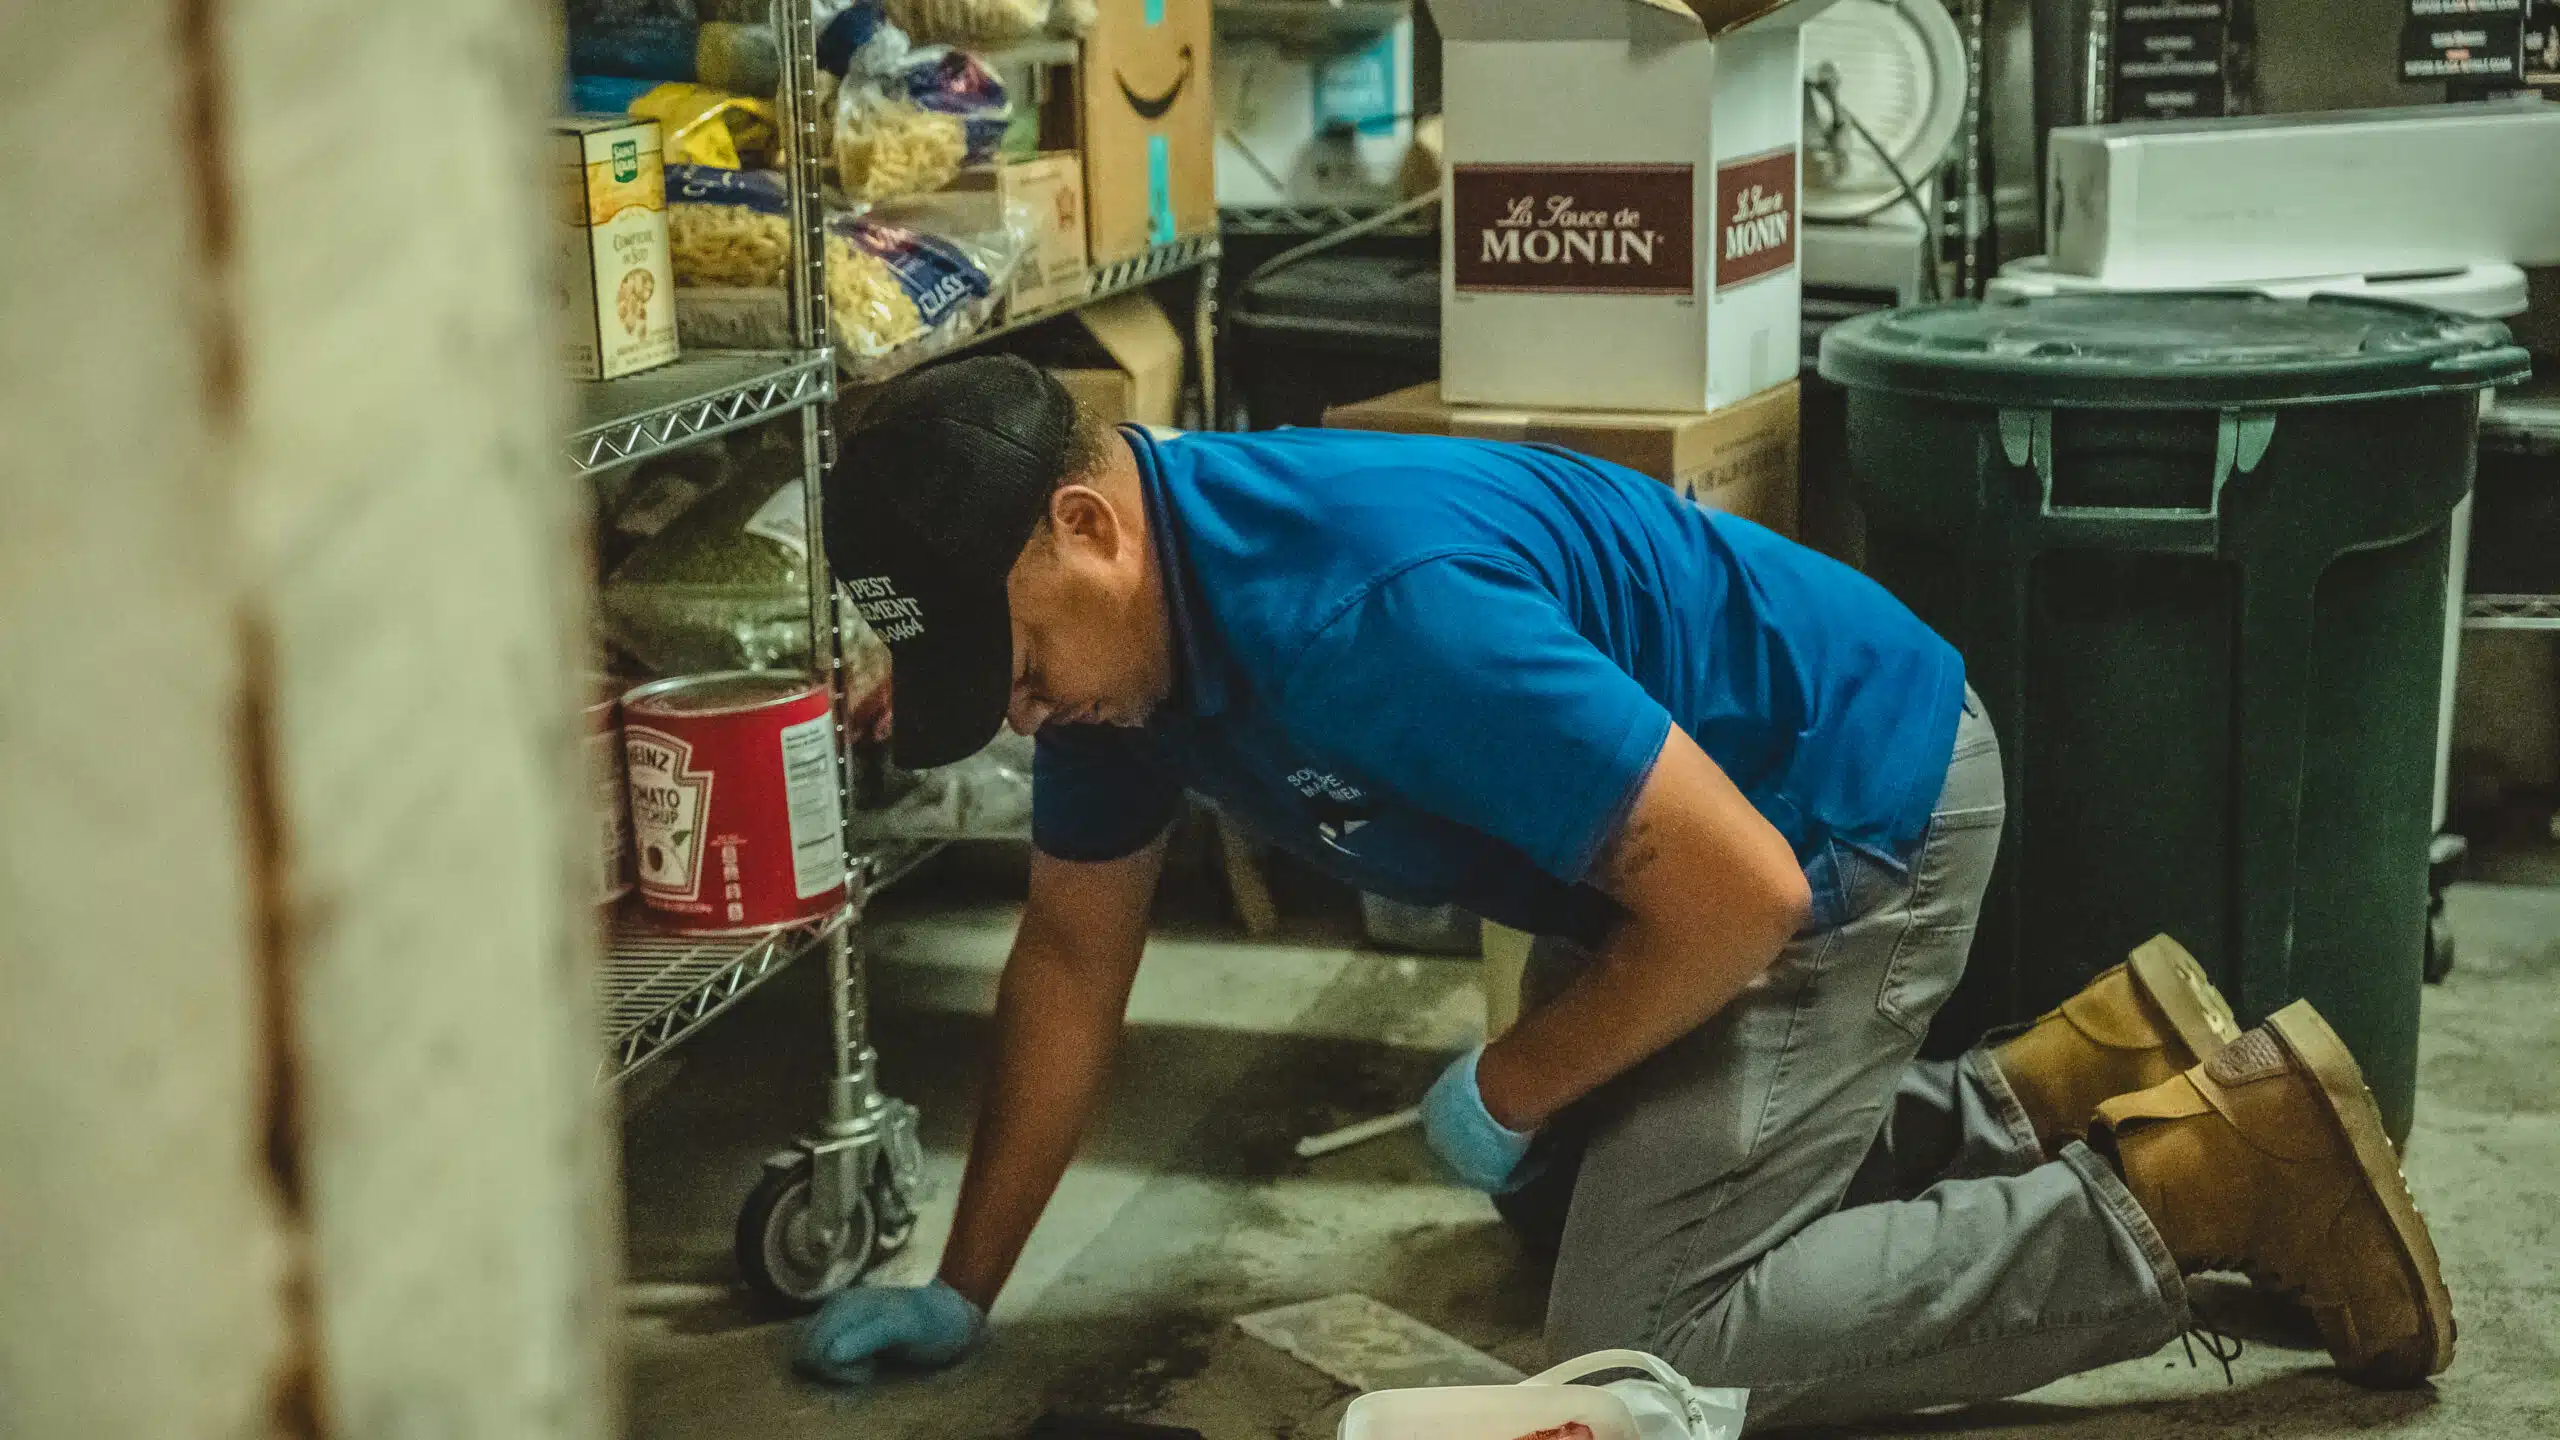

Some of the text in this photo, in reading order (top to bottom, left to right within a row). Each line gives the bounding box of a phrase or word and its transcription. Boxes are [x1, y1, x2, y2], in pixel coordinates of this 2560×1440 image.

[1495, 196, 1640, 228] La Sauce de
[1480, 228, 1655, 265] MONIN
[1725, 210, 1790, 260] MONIN
[848, 576, 896, 601] PEST
[857, 597, 924, 621] EMENT
